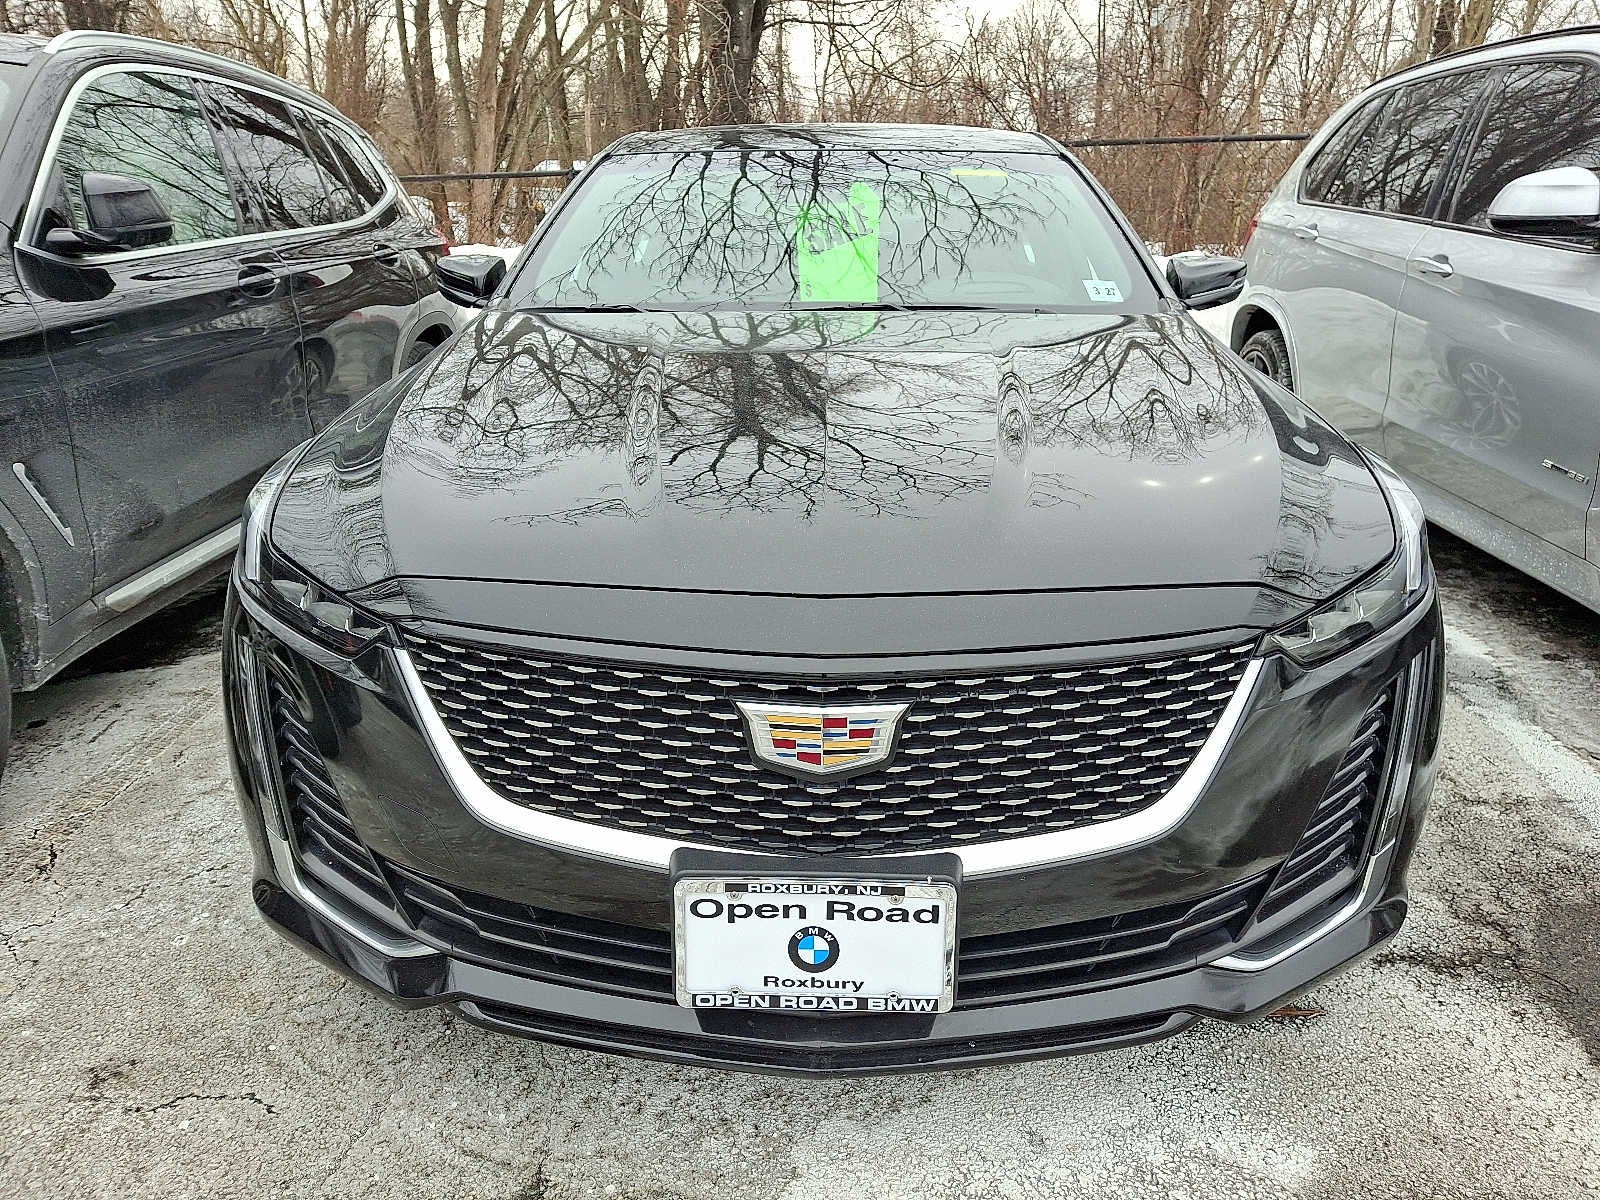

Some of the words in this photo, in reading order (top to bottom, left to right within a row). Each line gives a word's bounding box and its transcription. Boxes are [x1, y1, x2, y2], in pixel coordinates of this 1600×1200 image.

[747, 883, 849, 896] ROXBURY,
[856, 884, 882, 896] NJ
[690, 899, 807, 923] Open
[826, 900, 940, 925] Road
[794, 926, 835, 942] BMW
[764, 976, 865, 993] Roxbury
[695, 994, 770, 1009] OPEN
[780, 995, 858, 1010] ROAD
[867, 996, 935, 1012] BMW
